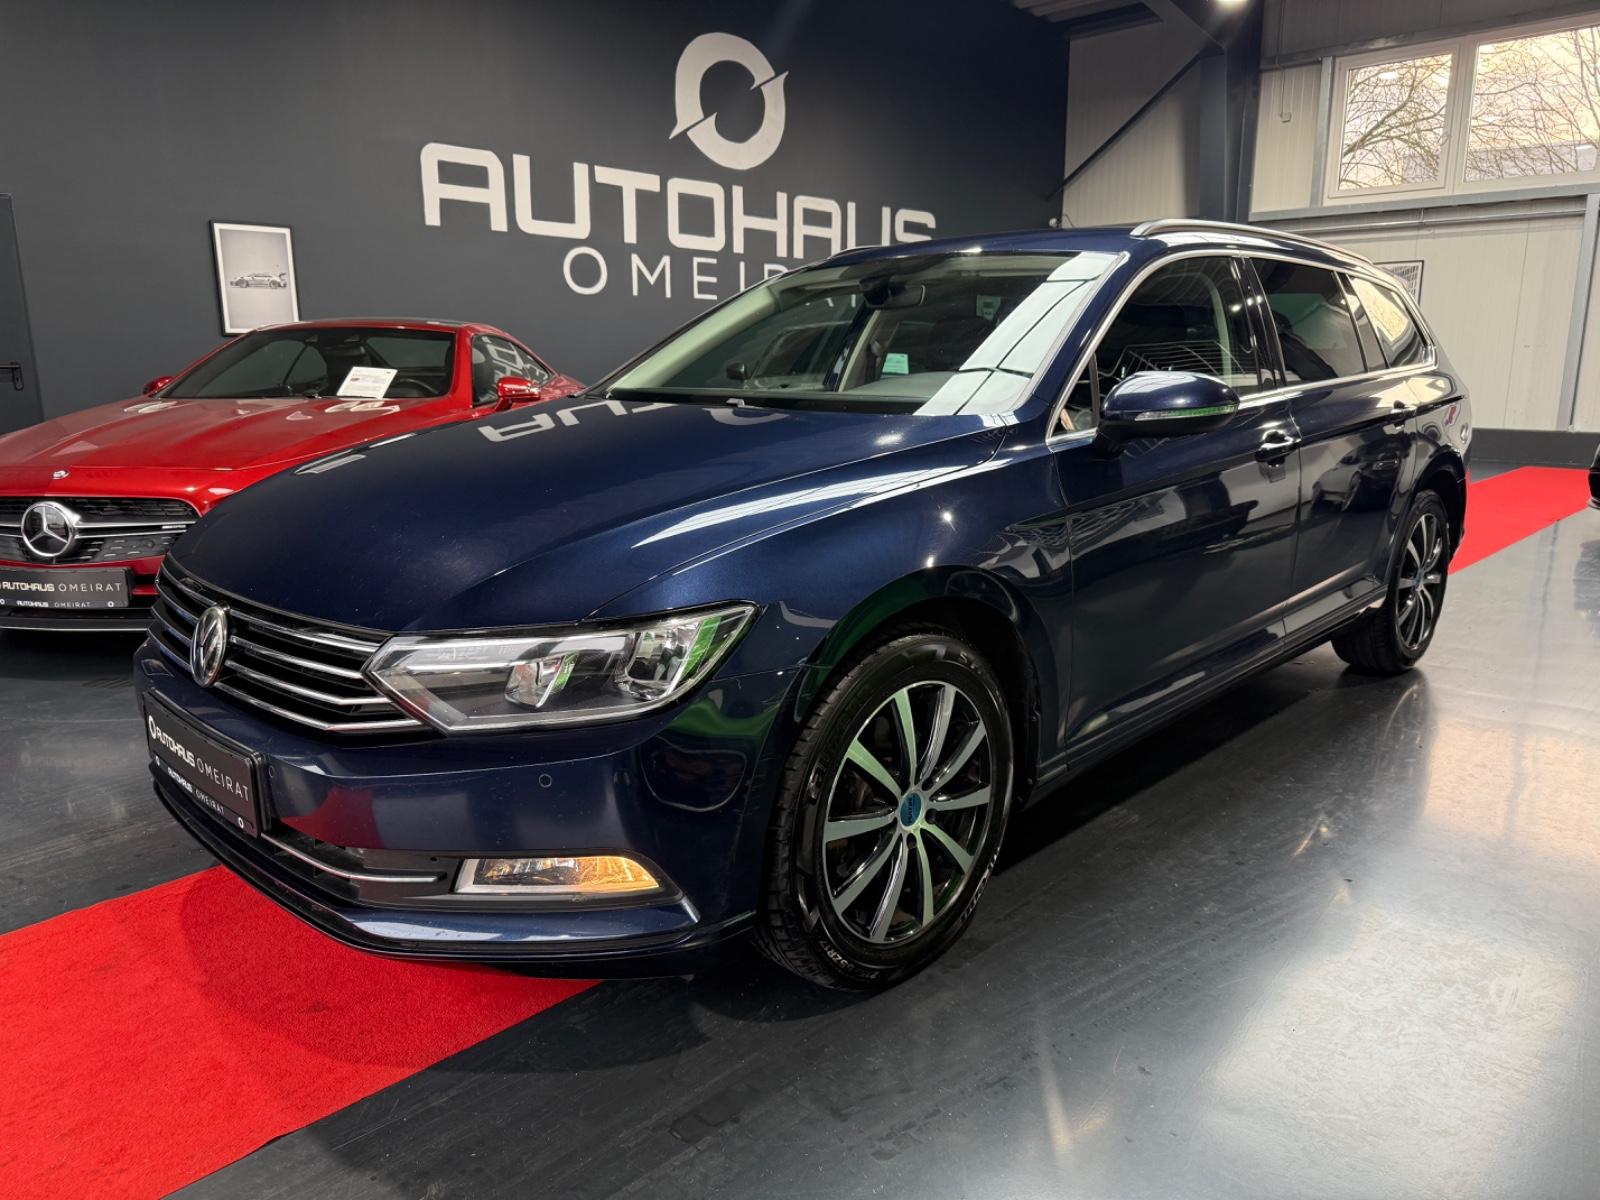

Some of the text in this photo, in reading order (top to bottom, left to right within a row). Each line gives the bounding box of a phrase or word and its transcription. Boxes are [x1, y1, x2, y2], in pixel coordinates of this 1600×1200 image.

[420, 142, 937, 260] AUTOHAUS
[2, 581, 122, 592] AUTOHAUS OMEIRAT
[155, 727, 249, 802] AUTOHAUS OMEIRAT
[195, 790, 225, 814] OMEIRAT
